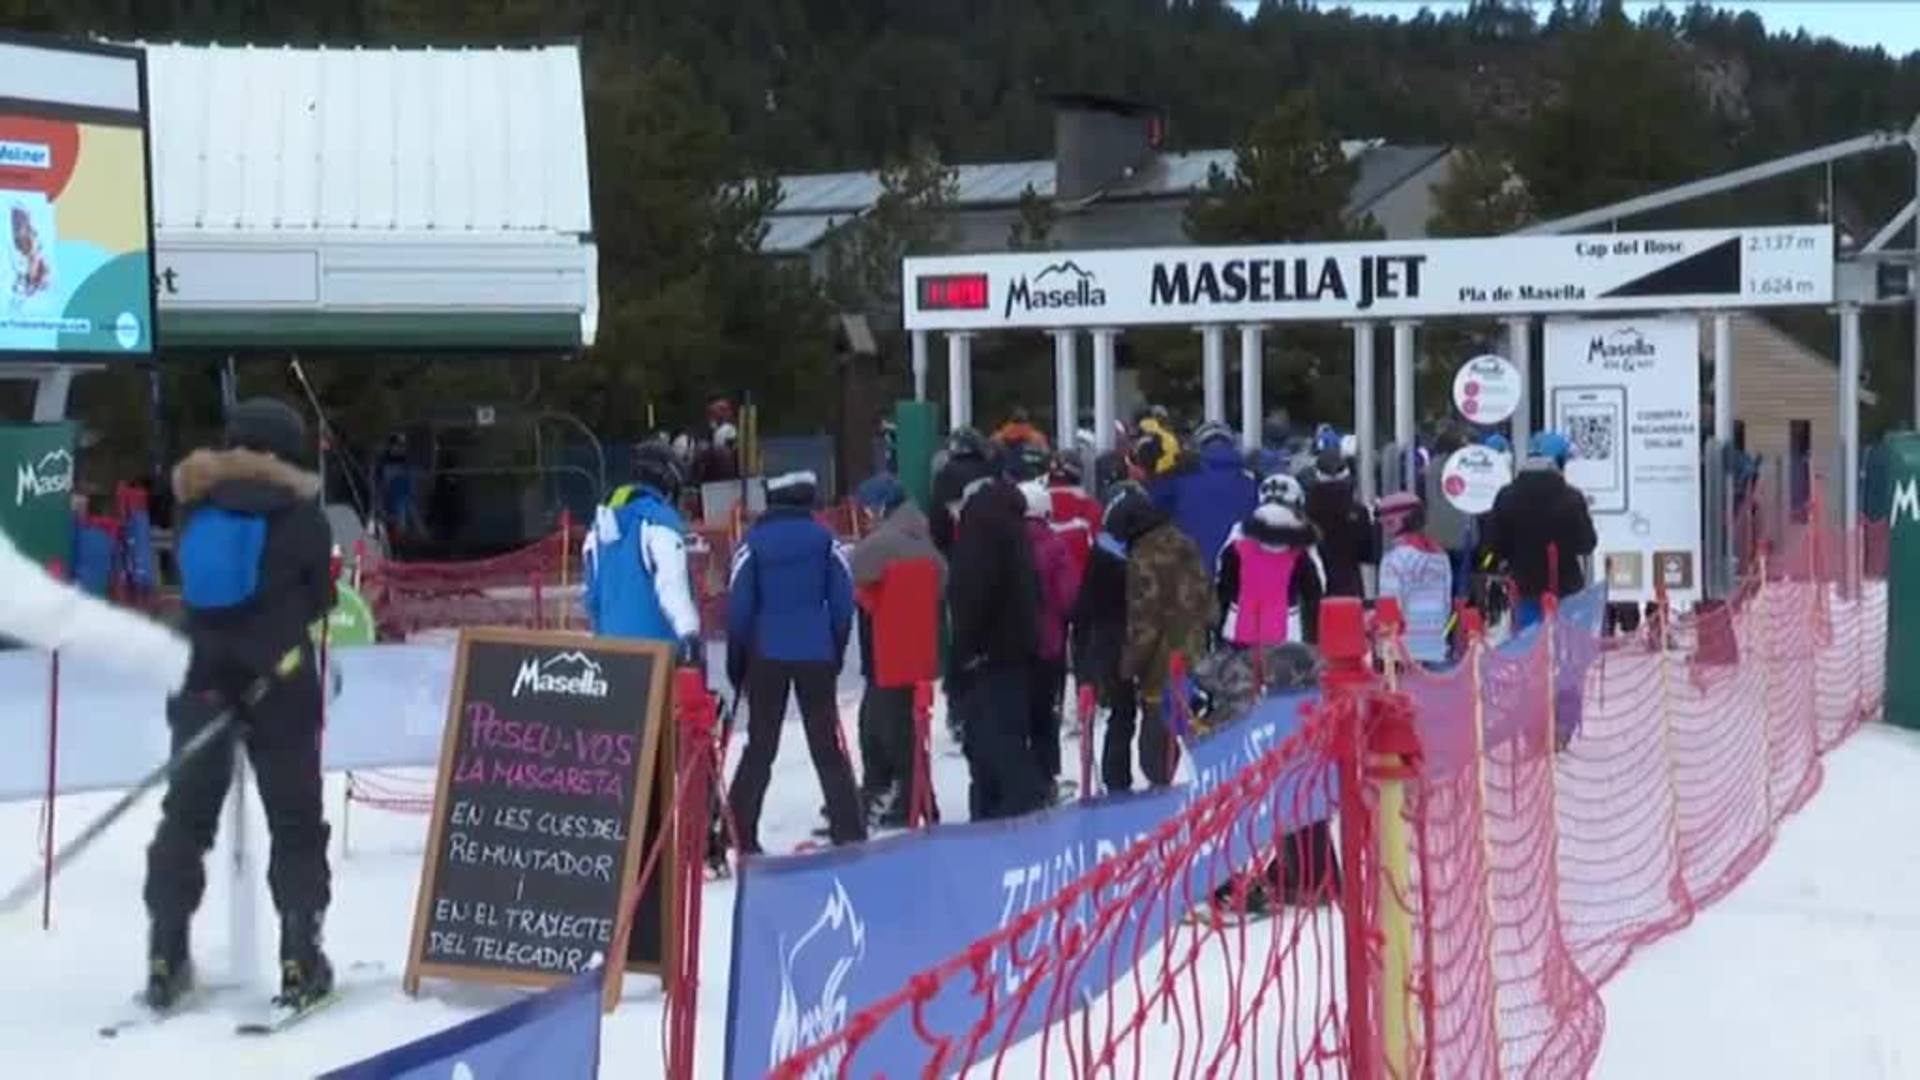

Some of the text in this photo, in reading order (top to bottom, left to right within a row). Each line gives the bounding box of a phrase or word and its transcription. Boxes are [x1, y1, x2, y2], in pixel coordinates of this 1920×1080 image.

[1574, 241, 1608, 259] Cap
[1613, 239, 1639, 256] del
[1797, 237, 1815, 249] m
[1150, 254, 1427, 310] MASELLA JET
[1458, 283, 1586, 302] Pla de Masella
[1796, 280, 1815, 293] m
[1004, 273, 1107, 319] Masella
[1587, 335, 1656, 363] Masella
[511, 657, 608, 698] Masella
[454, 755, 484, 782] LA
[451, 800, 483, 826] EN
[494, 808, 532, 832] LES
[449, 832, 614, 882] REMUNTADOR
[435, 900, 467, 923] EN
[474, 903, 498, 927] EL
[430, 931, 466, 955] DEL
